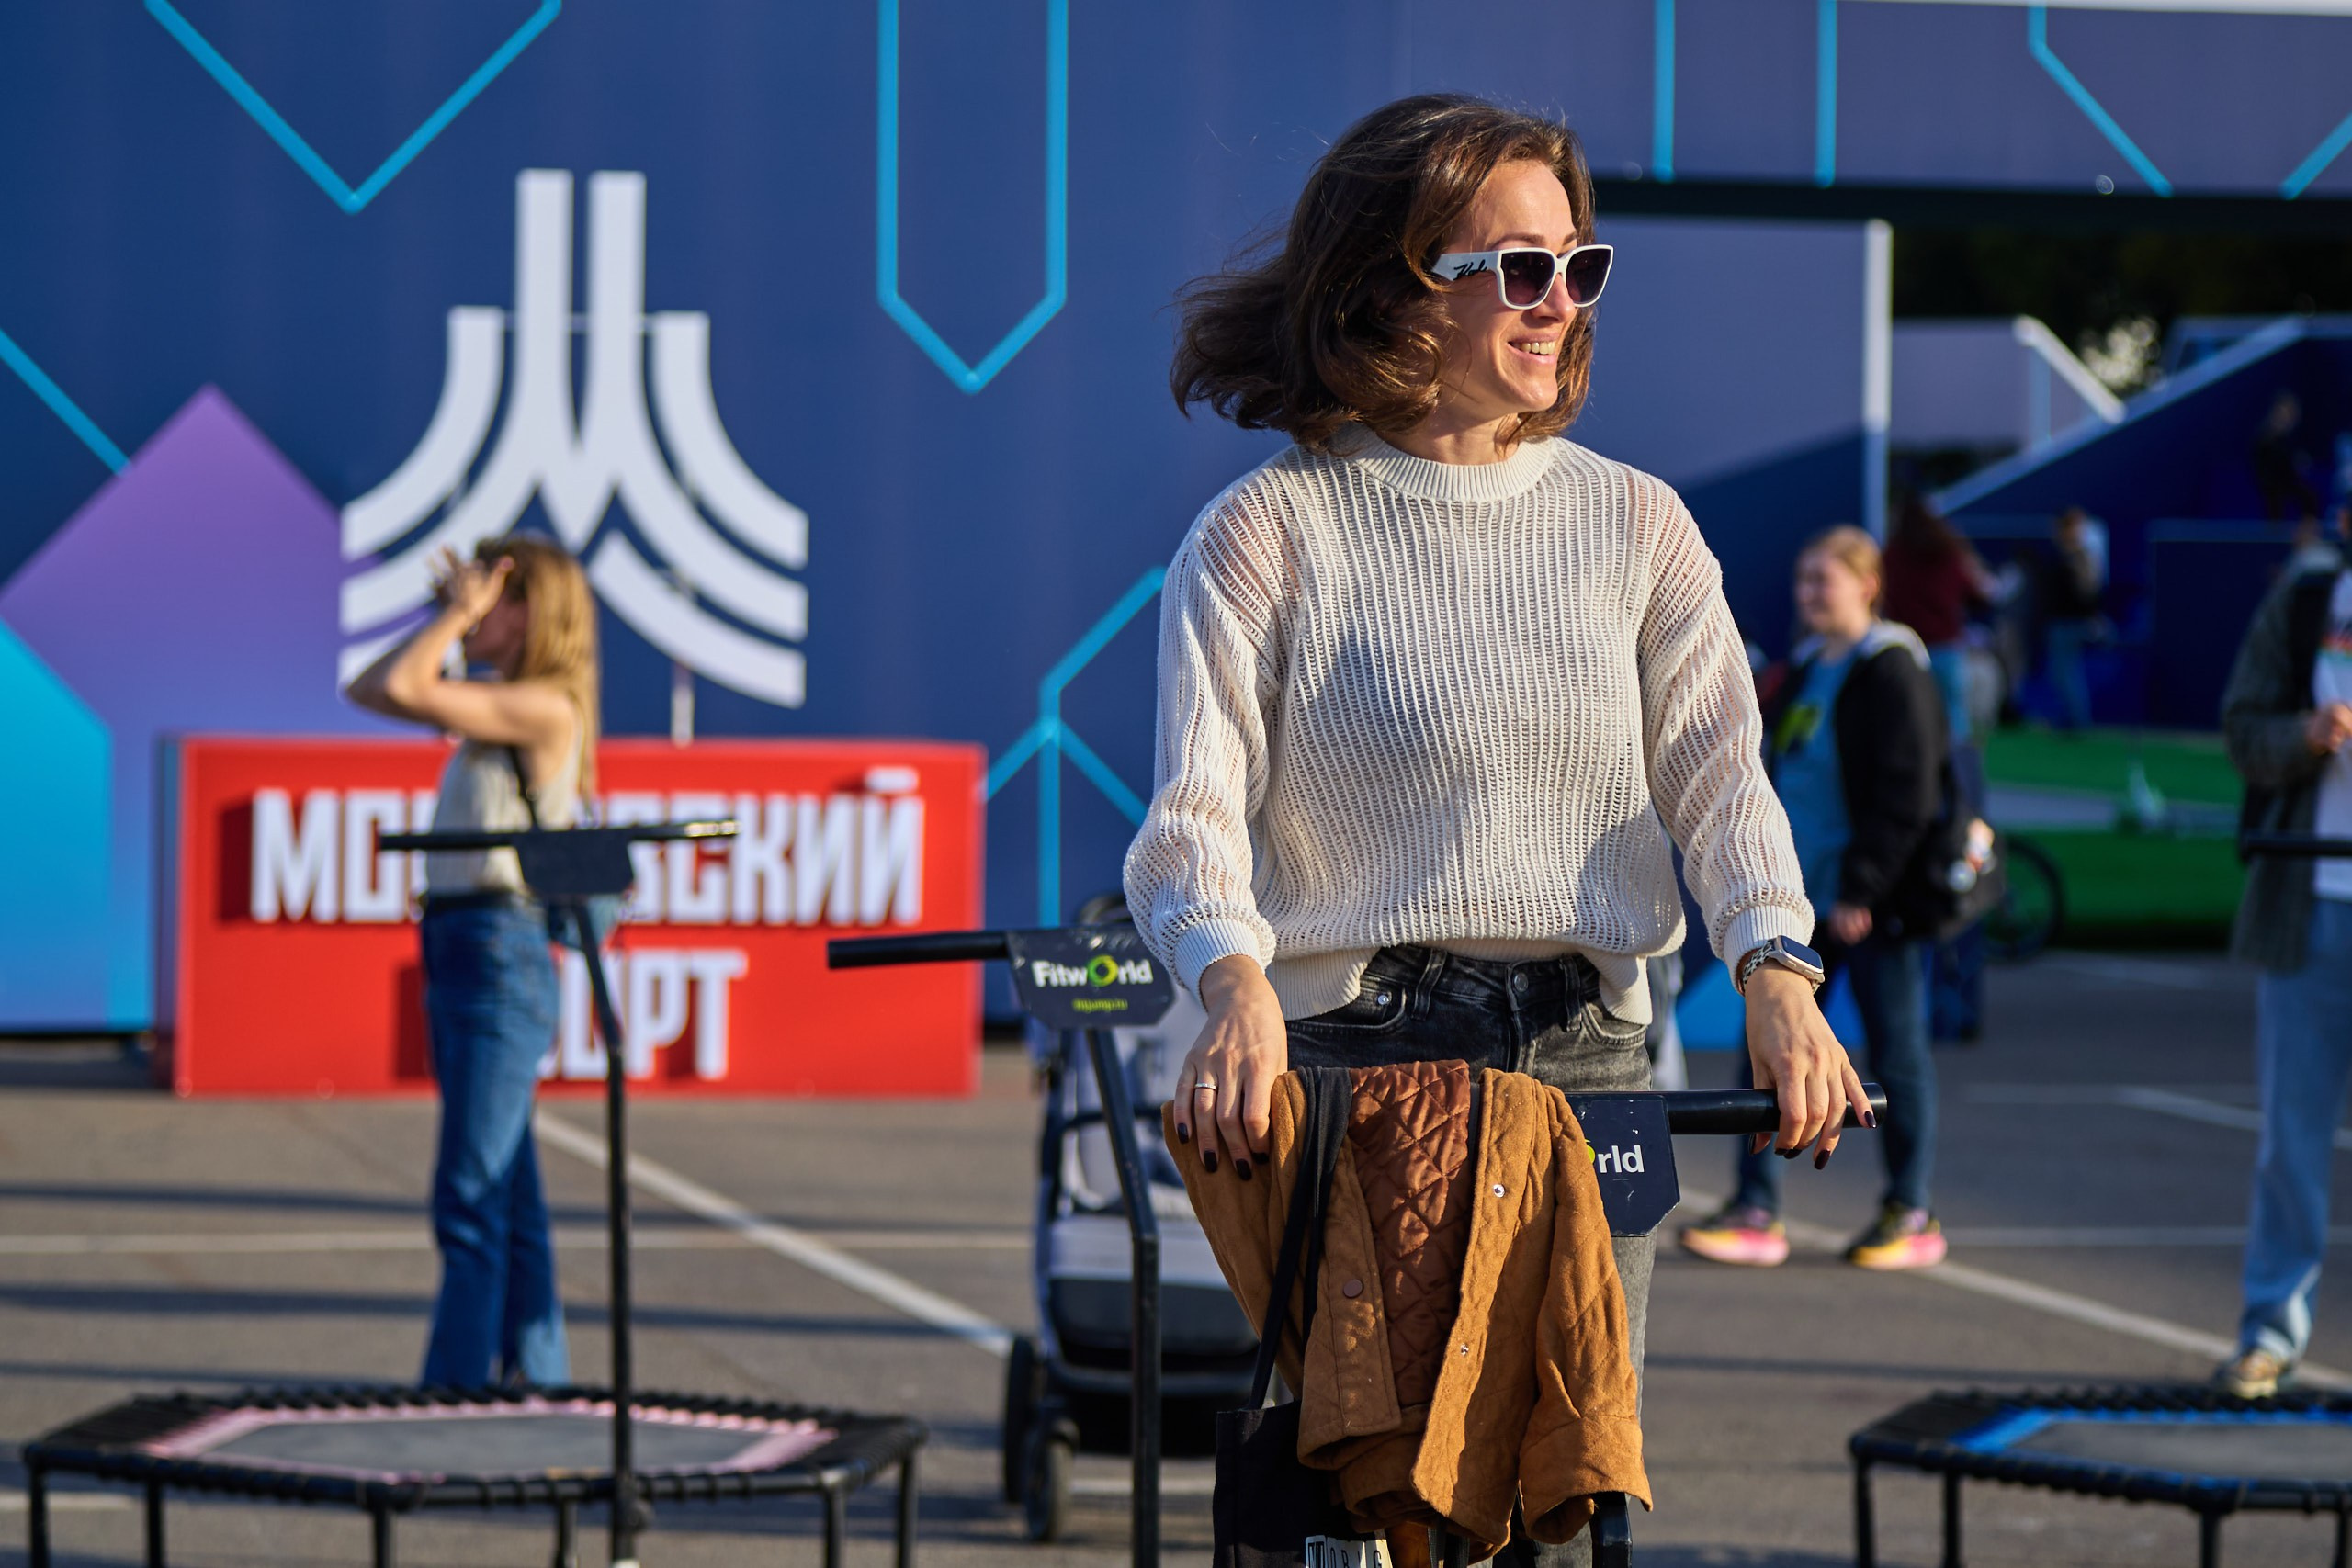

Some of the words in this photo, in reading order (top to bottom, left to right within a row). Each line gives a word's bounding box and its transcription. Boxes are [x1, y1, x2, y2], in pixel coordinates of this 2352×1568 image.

[250, 767, 924, 925] МОВСКИЙ
[536, 948, 749, 1081] ОРТ
[1585, 1139, 1645, 1173] rld
